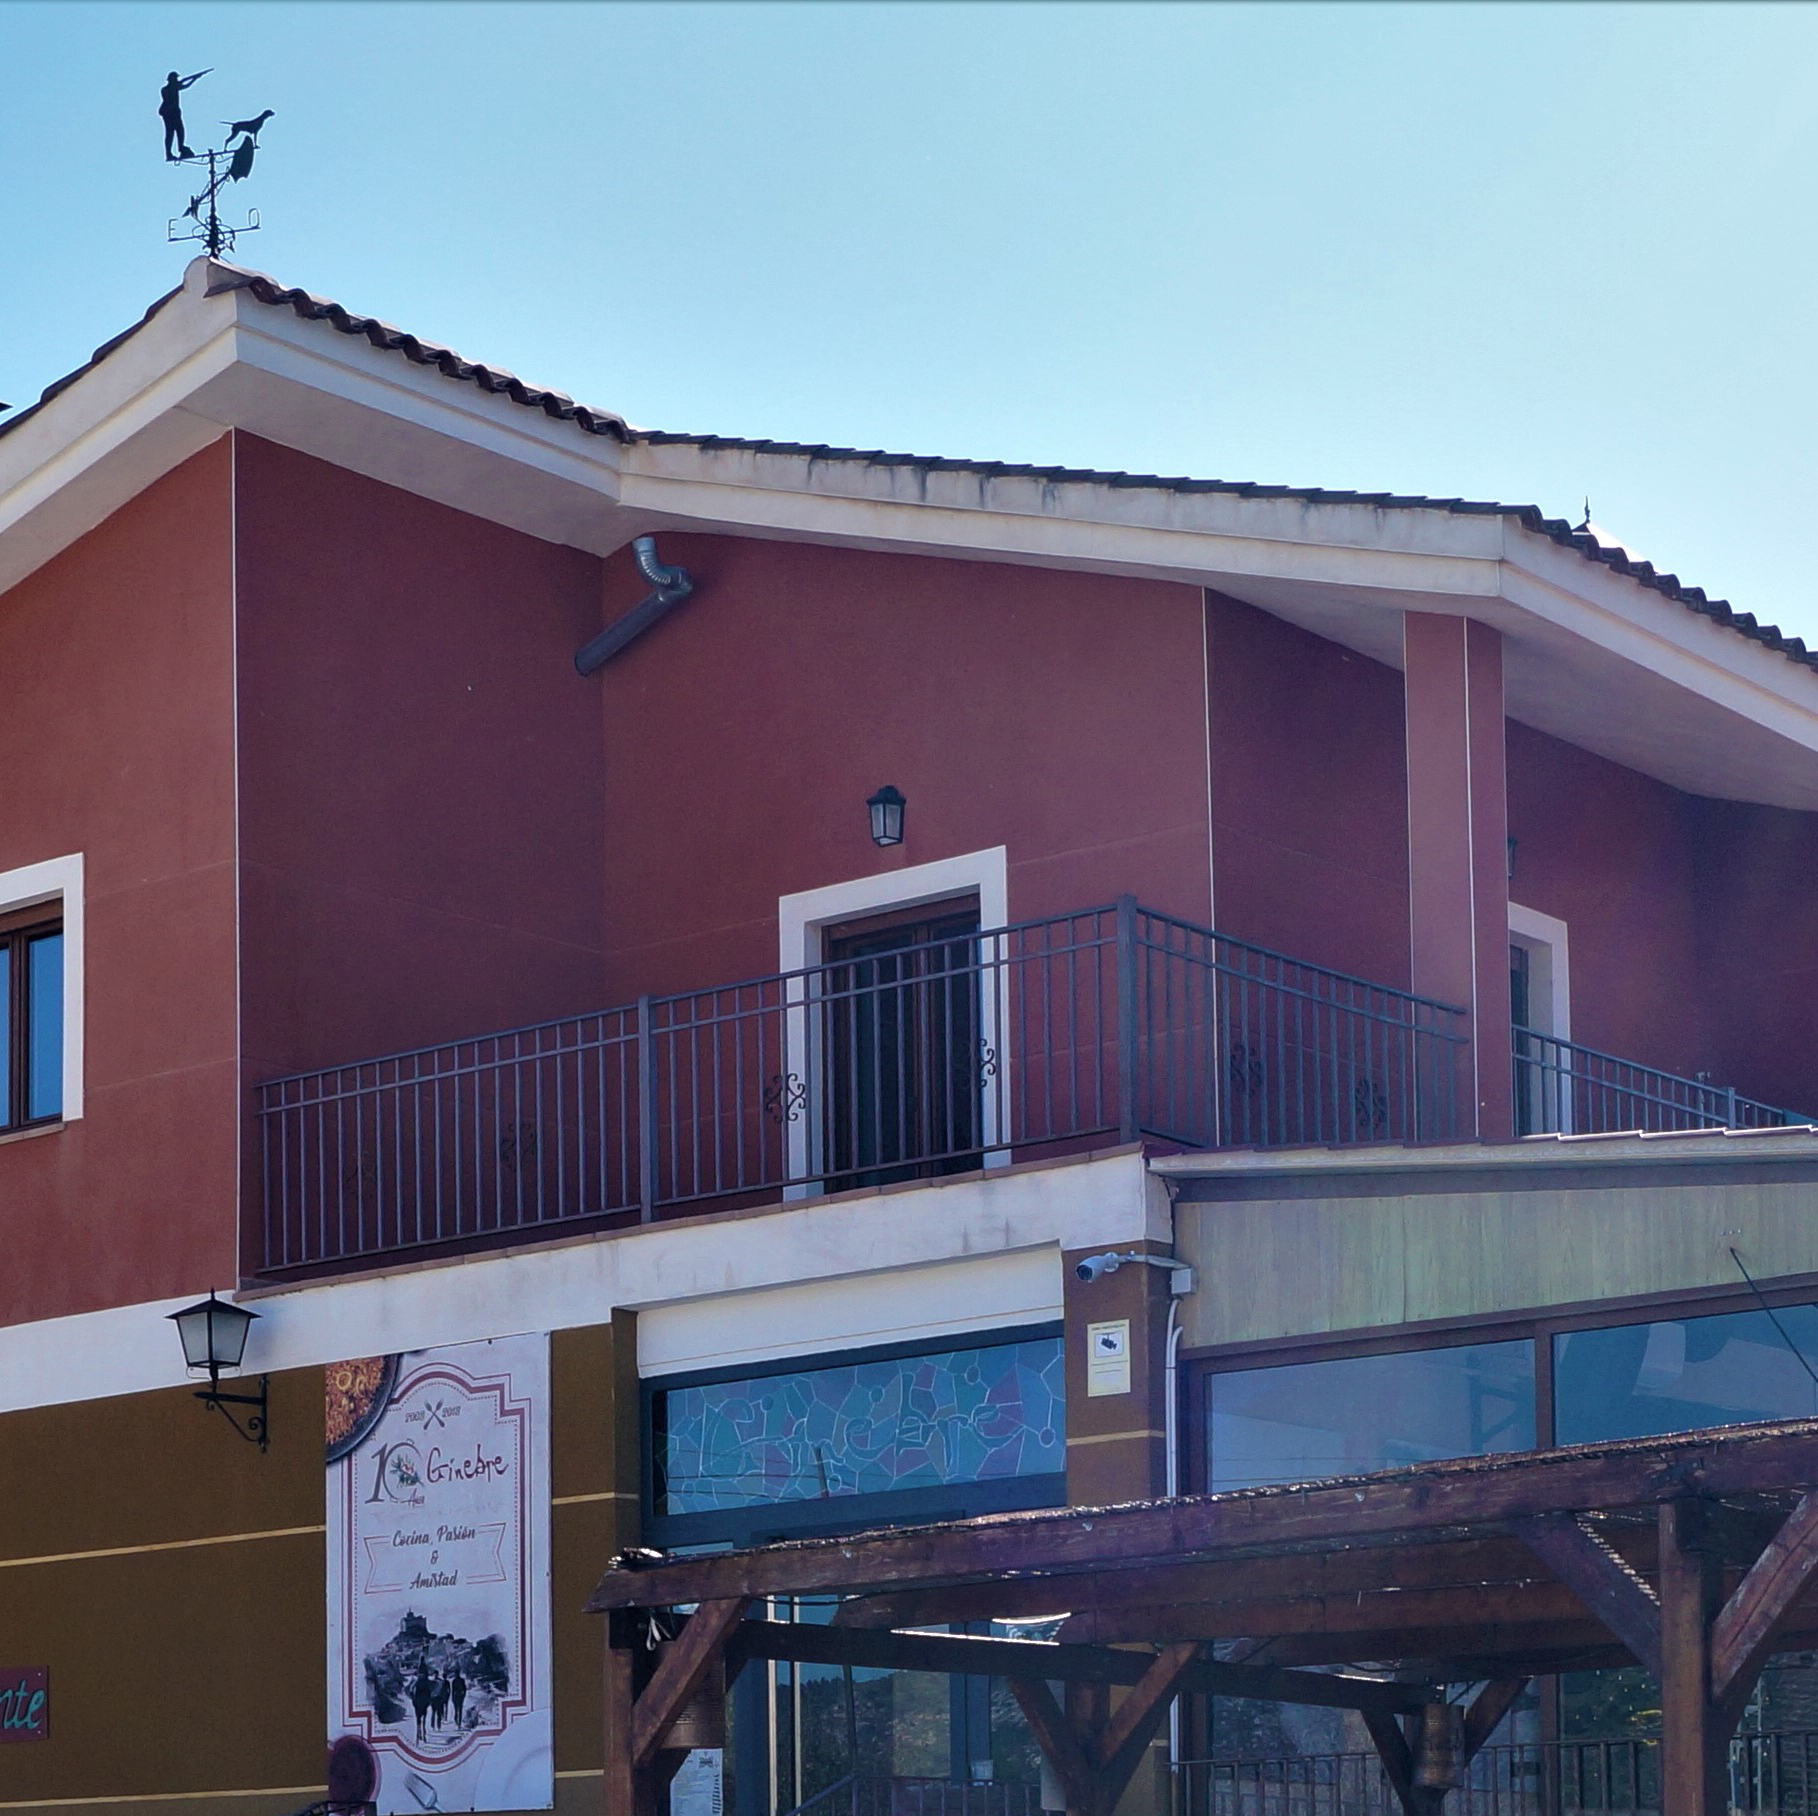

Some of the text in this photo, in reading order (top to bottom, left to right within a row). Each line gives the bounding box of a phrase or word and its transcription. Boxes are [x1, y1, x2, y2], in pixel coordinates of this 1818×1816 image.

[427, 1443, 510, 1483] Ginebre
[392, 1524, 476, 1548] Cocina, Pasión
[430, 1549, 439, 1565] &
[409, 1569, 459, 1590] Amistad
